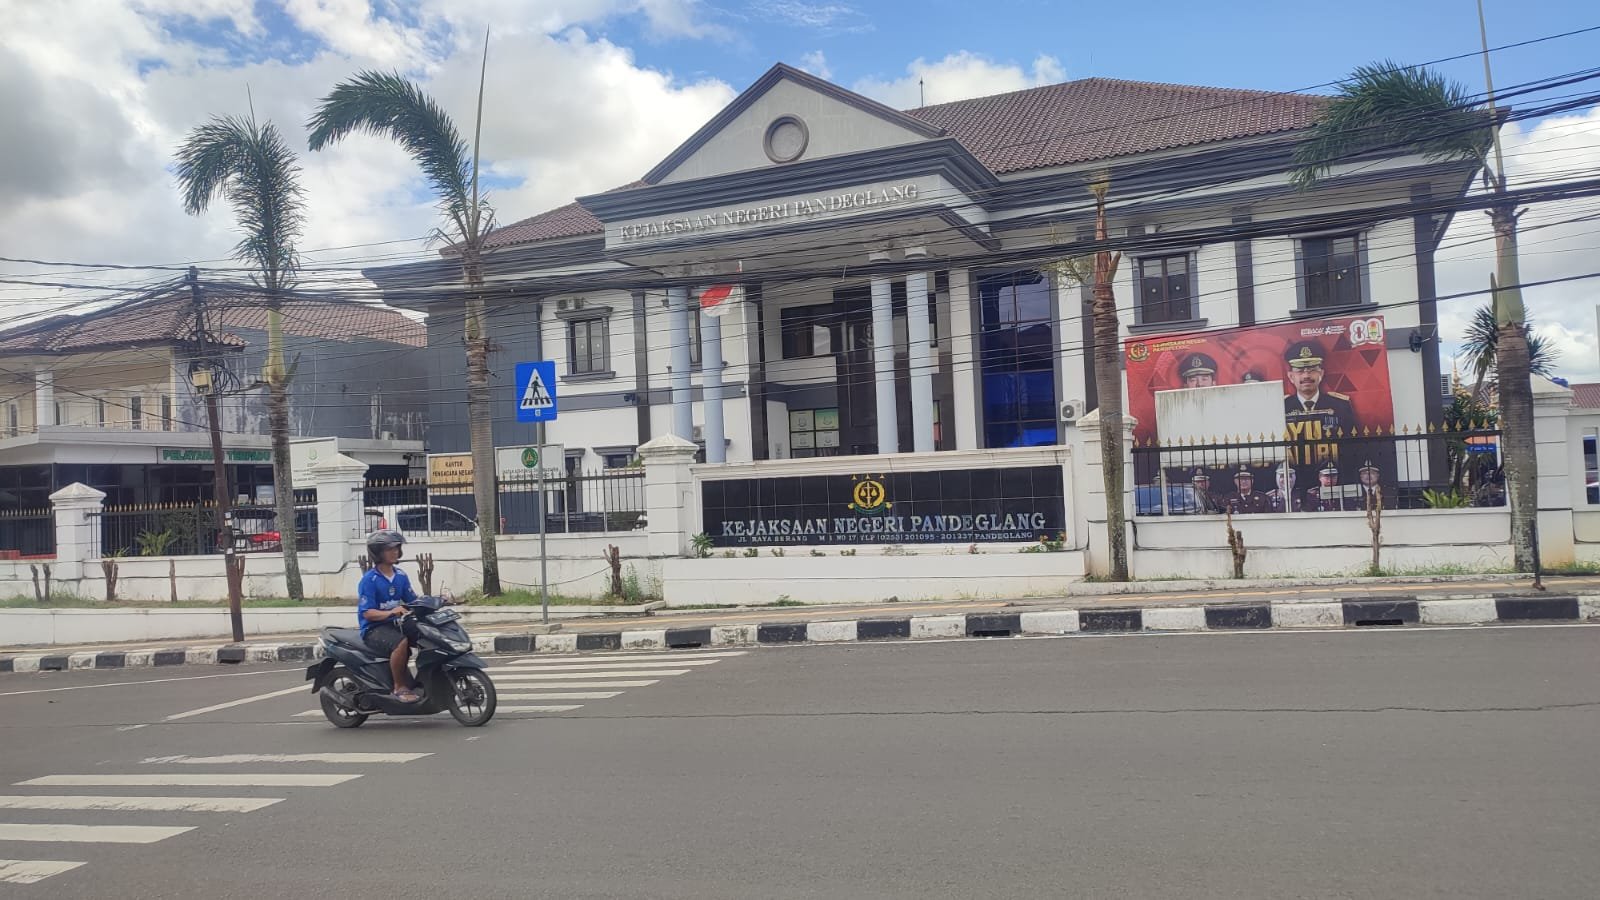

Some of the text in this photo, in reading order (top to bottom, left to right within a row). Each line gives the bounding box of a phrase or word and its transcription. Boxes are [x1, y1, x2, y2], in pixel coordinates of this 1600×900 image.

[620, 184, 919, 238] KEJAKSAAN NEGERI PANDEGLANG
[162, 449, 215, 461] PELAYANA
[721, 512, 1047, 537] KEJAKSAAN NEGERI PANDEGLANG
[975, 532, 1033, 540] PANDEGLANG
